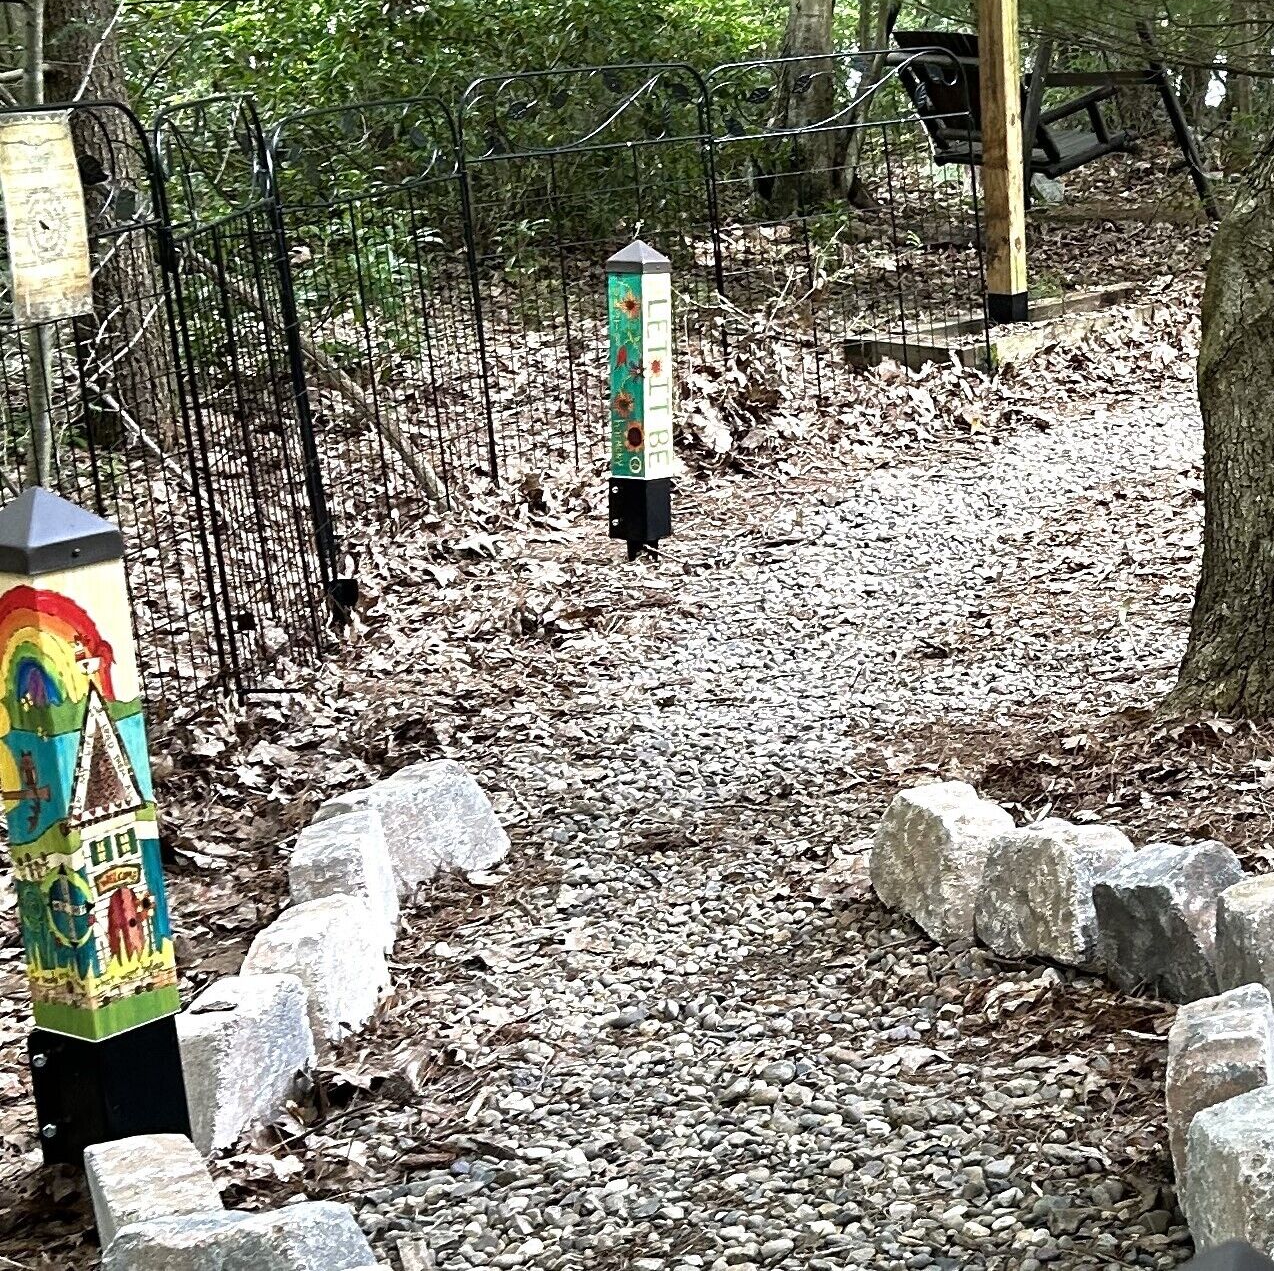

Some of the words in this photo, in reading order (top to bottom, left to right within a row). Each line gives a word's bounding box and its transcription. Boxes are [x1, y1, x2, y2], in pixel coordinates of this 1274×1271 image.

[647, 299, 668, 357] LET
[648, 376, 669, 416] IT
[648, 429, 669, 469] BE
